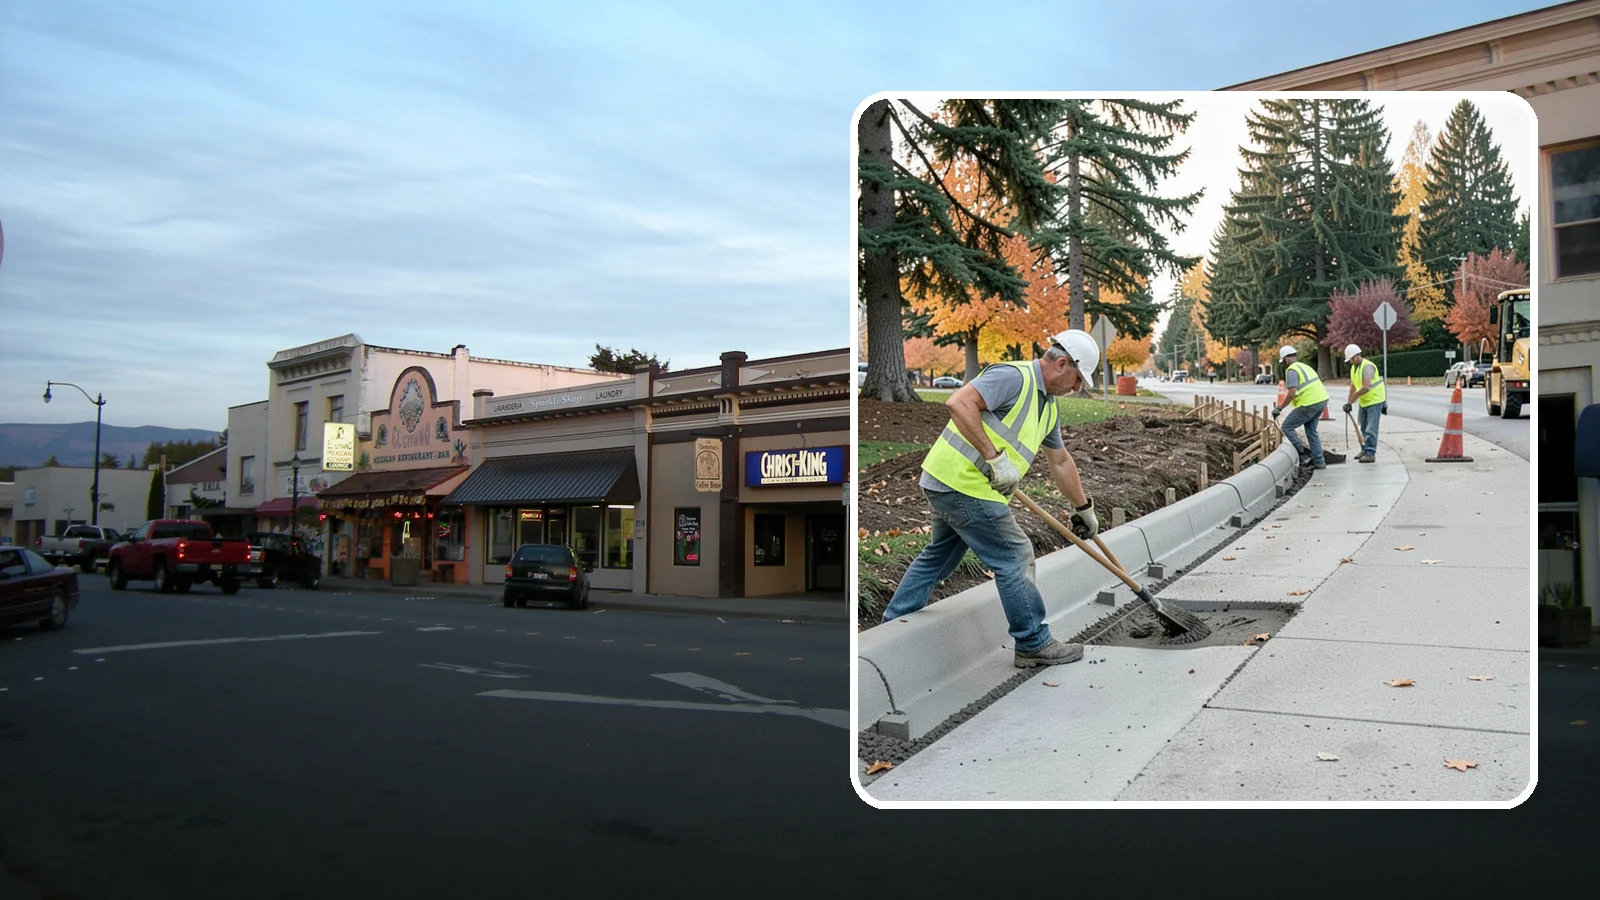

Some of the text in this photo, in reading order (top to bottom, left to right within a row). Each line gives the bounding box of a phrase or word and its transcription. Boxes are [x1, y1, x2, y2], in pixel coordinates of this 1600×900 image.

[595, 388, 624, 400] LAUNDRY
[493, 402, 523, 413] LAVANDERIA
[530, 394, 583, 409] Sparkle Shop
[373, 454, 396, 464] MEXICAN
[397, 451, 433, 463] RESTAURANT
[438, 450, 450, 460] BAR
[799, 450, 827, 476] KING
